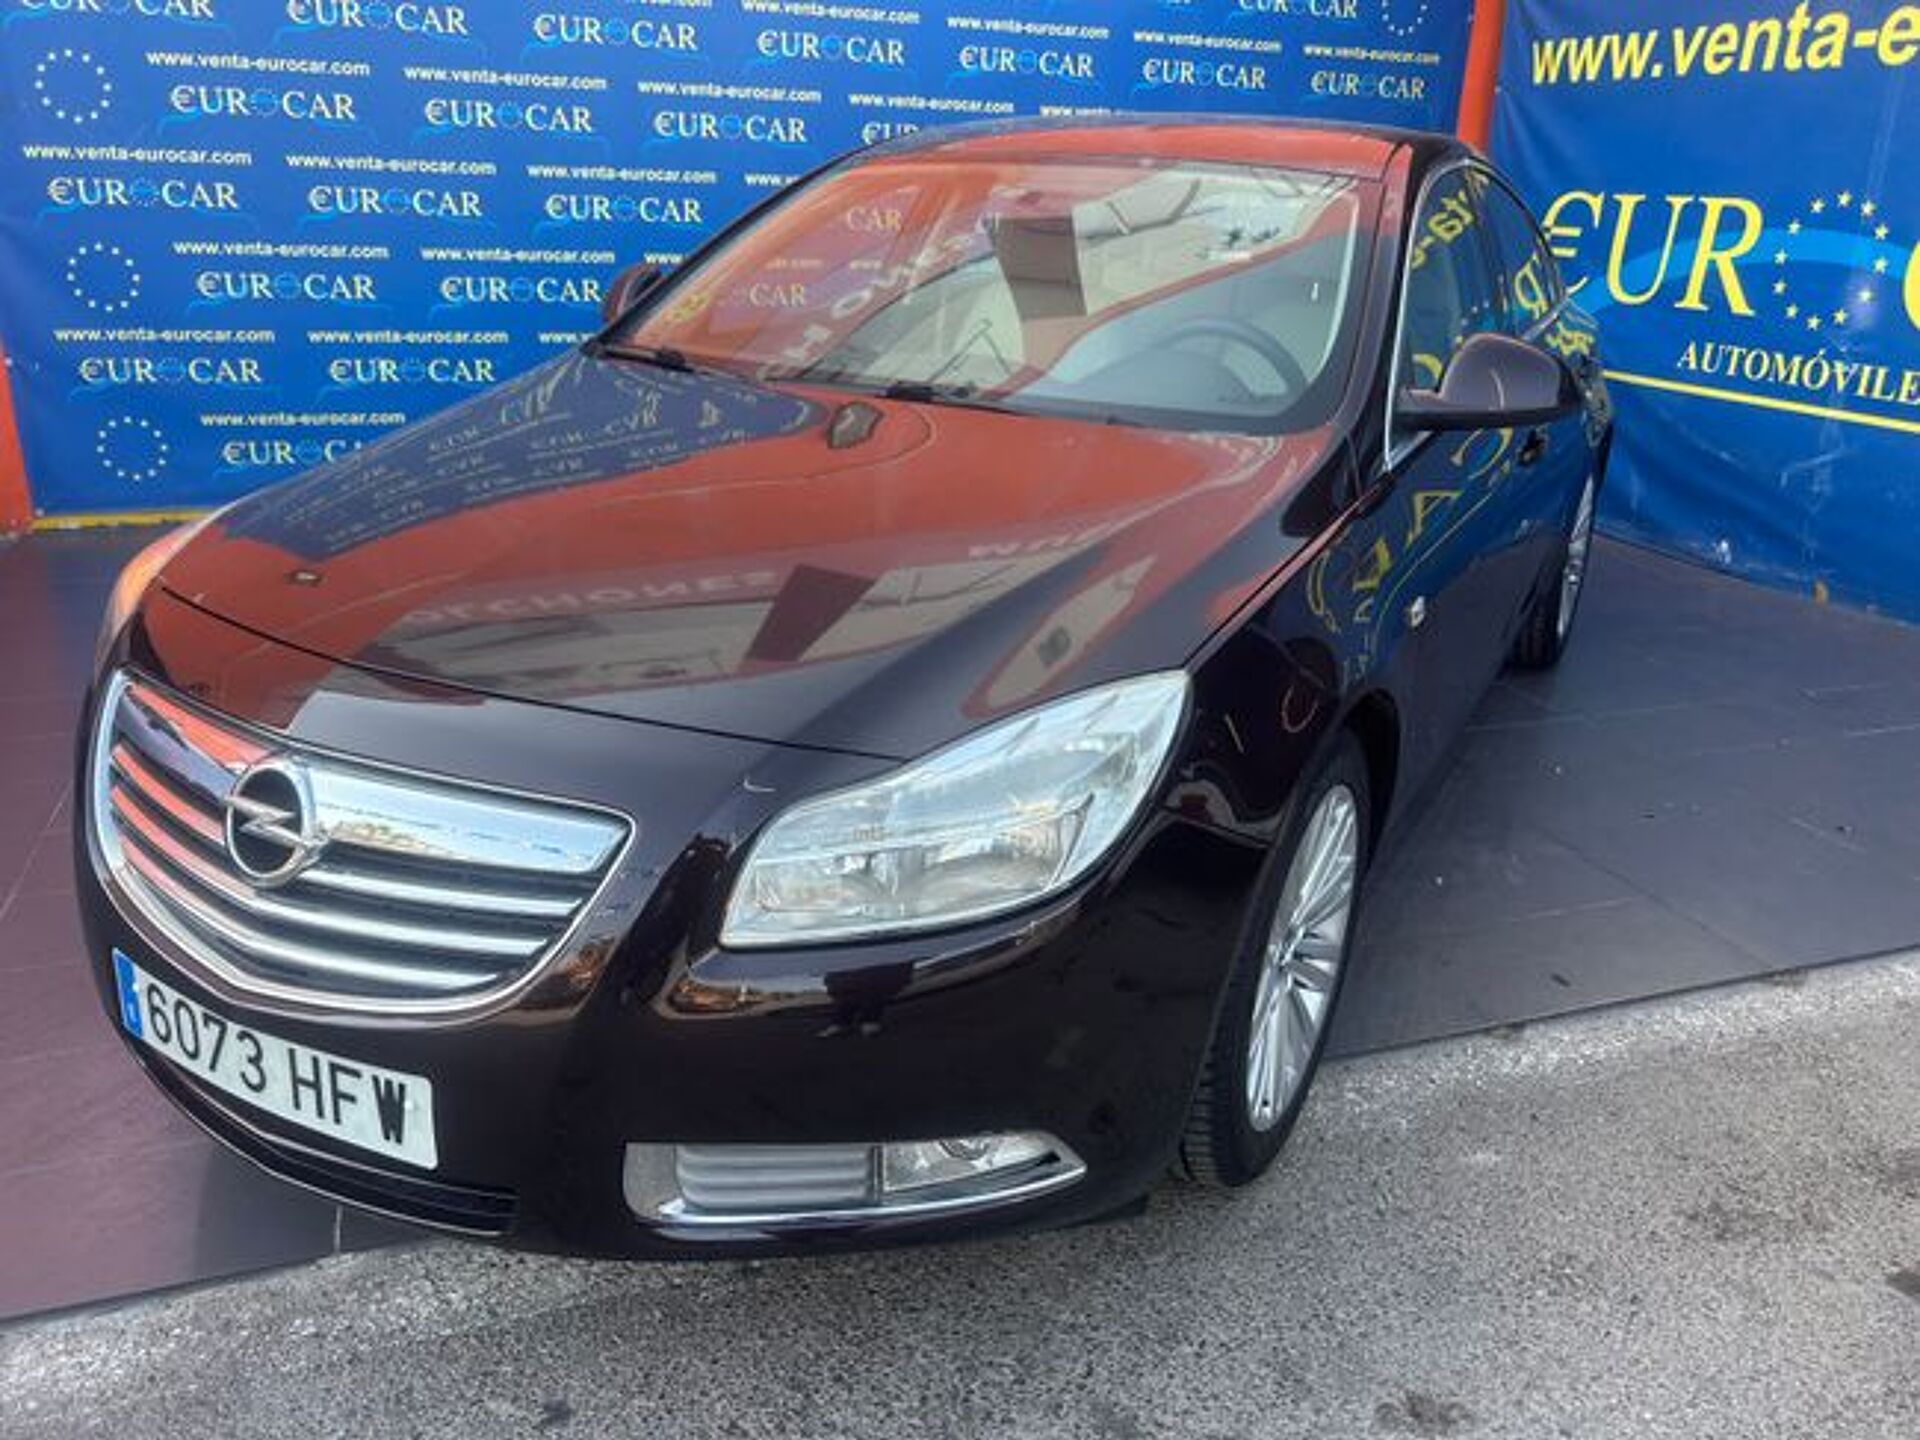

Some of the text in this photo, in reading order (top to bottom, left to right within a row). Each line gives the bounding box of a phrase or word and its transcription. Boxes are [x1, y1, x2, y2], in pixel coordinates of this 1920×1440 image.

[946, 15, 1110, 39] www.venta-eurocar.com
[1133, 29, 1283, 53] www.venta-eurocar.com
[146, 50, 371, 77] www.venta-eurocar.com
[404, 65, 607, 91] www.venta-eurocar.com
[638, 78, 822, 103] www.venta-eurocar.com
[848, 92, 1015, 114] www.venta-eurocar.com
[23, 142, 252, 167] www.venta-eurocar.com
[286, 152, 497, 176] www.venta-eurocar.com
[528, 162, 717, 185] www.venta-eurocar.com
[173, 241, 389, 261] www.venta-eurocar.com
[421, 247, 615, 264] www.venta-eurocar.com
[54, 327, 275, 344] www.venta-eurocar.com
[308, 330, 509, 344] www.venta-eurocar.com
[201, 411, 405, 428] www.venta-eurocar.com
[147, 983, 406, 1144] 6073 HFW
